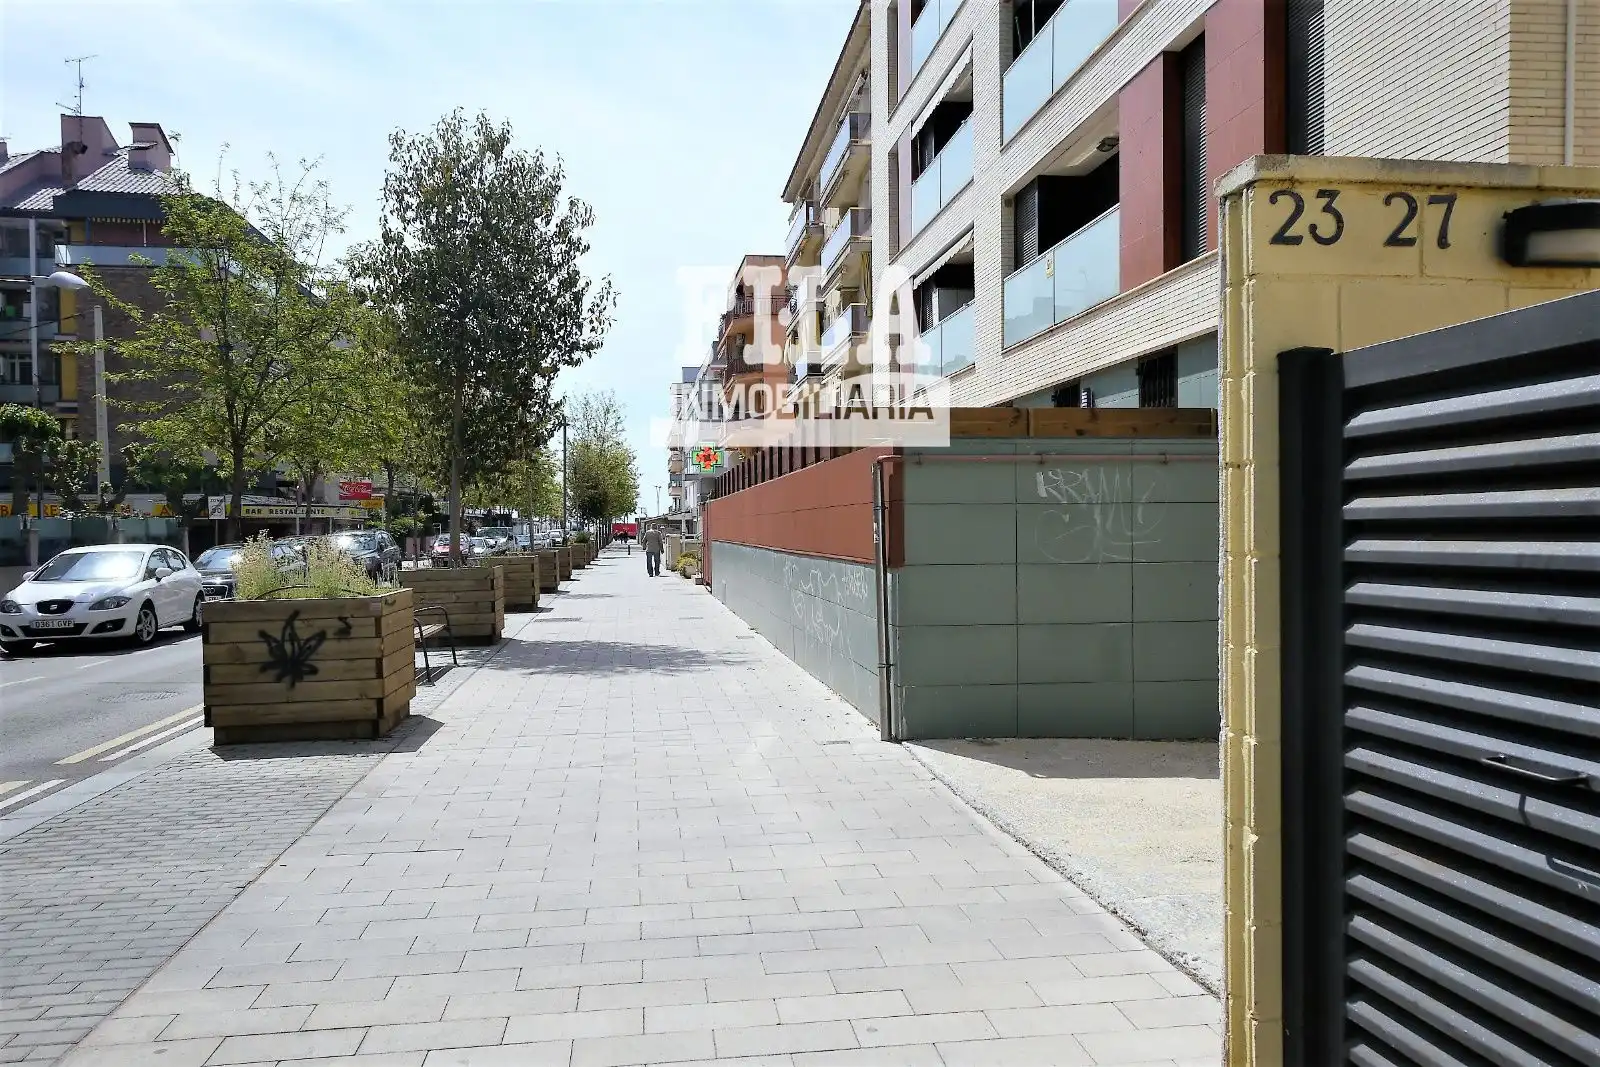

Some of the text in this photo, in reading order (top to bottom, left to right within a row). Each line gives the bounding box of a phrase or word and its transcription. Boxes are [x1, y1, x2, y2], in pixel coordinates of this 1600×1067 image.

[1269, 189, 1458, 249] 23 27
[269, 508, 325, 516] RESTAUNTE
